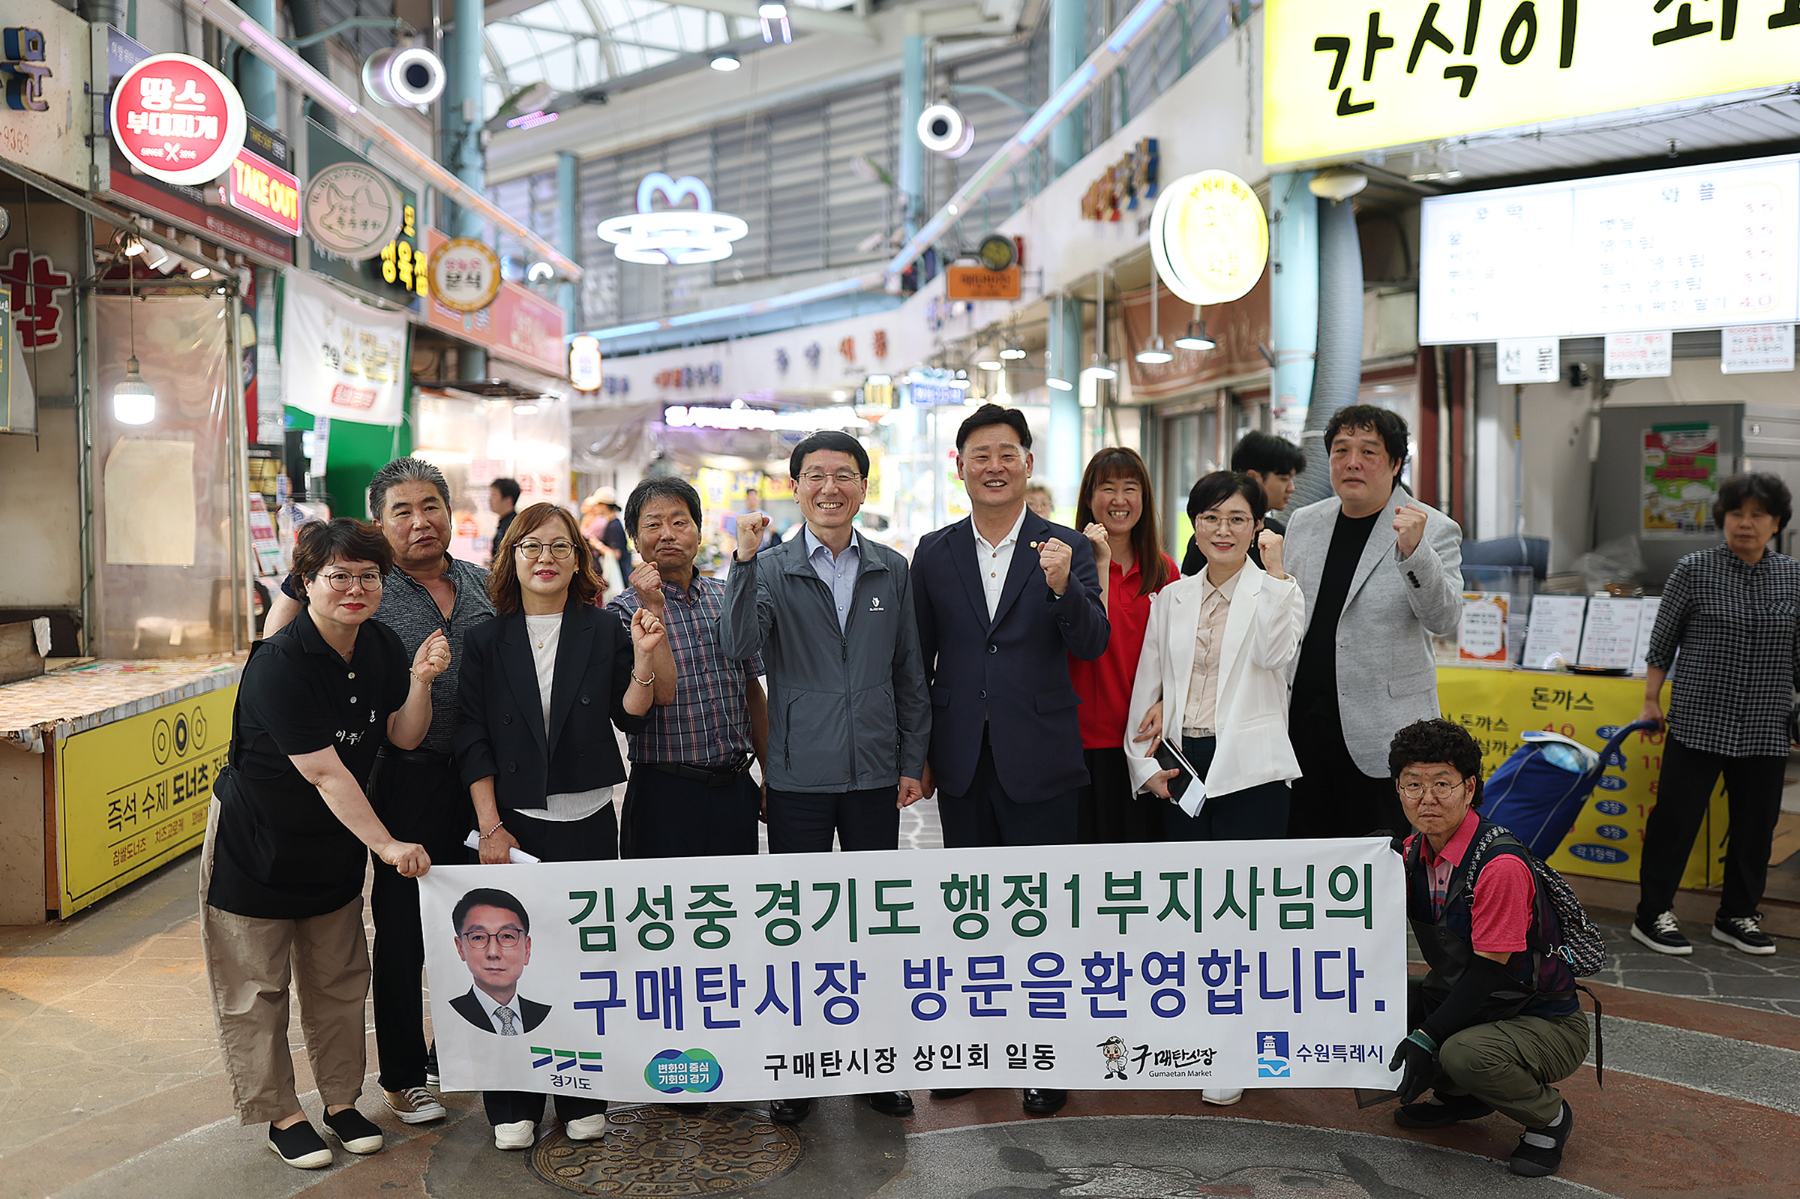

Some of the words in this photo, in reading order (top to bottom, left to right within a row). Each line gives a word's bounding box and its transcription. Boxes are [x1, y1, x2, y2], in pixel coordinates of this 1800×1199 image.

[1314, 0, 1578, 117] 간식이
[1652, 0, 1800, 46] 최
[140, 77, 207, 112] 땅스
[126, 111, 219, 140] 부대찌개
[140, 147, 164, 158] SINCE
[233, 158, 270, 208] TAKE
[269, 178, 299, 222] OUT
[1530, 686, 1595, 711] 돈까스
[1459, 713, 1510, 733] 돈까스
[107, 792, 137, 832] 즉석
[142, 778, 168, 820] 수제
[172, 763, 209, 806] 도너츠
[113, 837, 147, 867] 찹쌀도너츠
[567, 883, 738, 953] 김성중
[754, 877, 922, 947] 경기도
[939, 862, 1374, 941] 행정1부지사님의
[573, 959, 867, 1037] 구매탄시장
[902, 946, 1387, 1023] 방문을환영합니다.
[658, 1062, 688, 1074] 변화의
[689, 1061, 710, 1073] 중심
[763, 1046, 898, 1081] 구매탄시장
[912, 1042, 990, 1072] 상인회
[1004, 1042, 1057, 1072] 일동
[1130, 1044, 1218, 1075] 구매탄시장
[1295, 1043, 1384, 1064] 수원특례시
[549, 1073, 593, 1091] 경기도
[658, 1073, 688, 1085] 기회의
[689, 1072, 710, 1084] 경기
[1148, 1069, 1186, 1079] Gumaetan
[1187, 1069, 1213, 1078] Market
